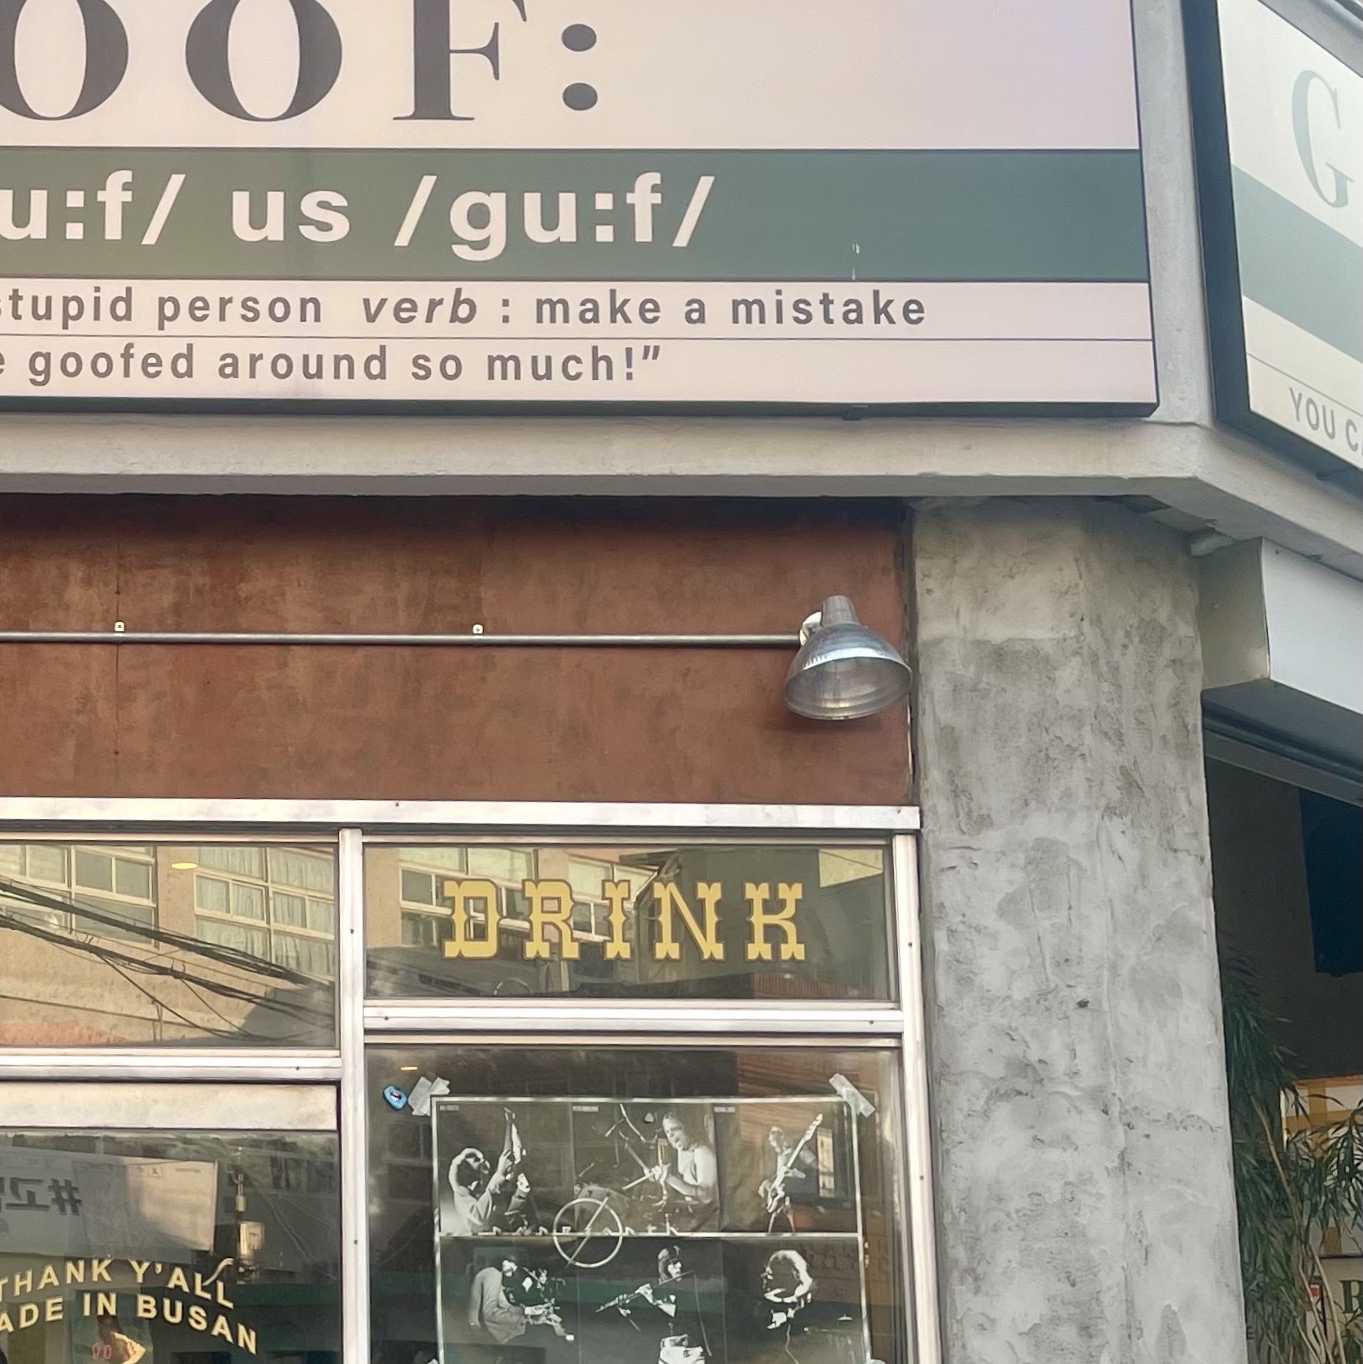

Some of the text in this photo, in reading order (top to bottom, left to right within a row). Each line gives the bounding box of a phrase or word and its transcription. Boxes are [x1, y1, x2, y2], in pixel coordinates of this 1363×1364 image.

[231, 190, 351, 244] us
[393, 171, 716, 262] /gu:f/
[157, 295, 323, 332] person
[362, 287, 478, 325] verb
[535, 289, 661, 325] make
[684, 298, 707, 325] a
[731, 288, 926, 326] mistake
[28, 342, 194, 387] goofed
[217, 344, 387, 381] around
[411, 353, 464, 381] so
[487, 344, 661, 383] much!"
[1289, 385, 1336, 441] YOU
[442, 879, 806, 961] DRINK
[127, 1258, 235, 1310] Y'ALL
[83, 1292, 117, 1317] IN
[136, 1294, 258, 1356] BUSAN
